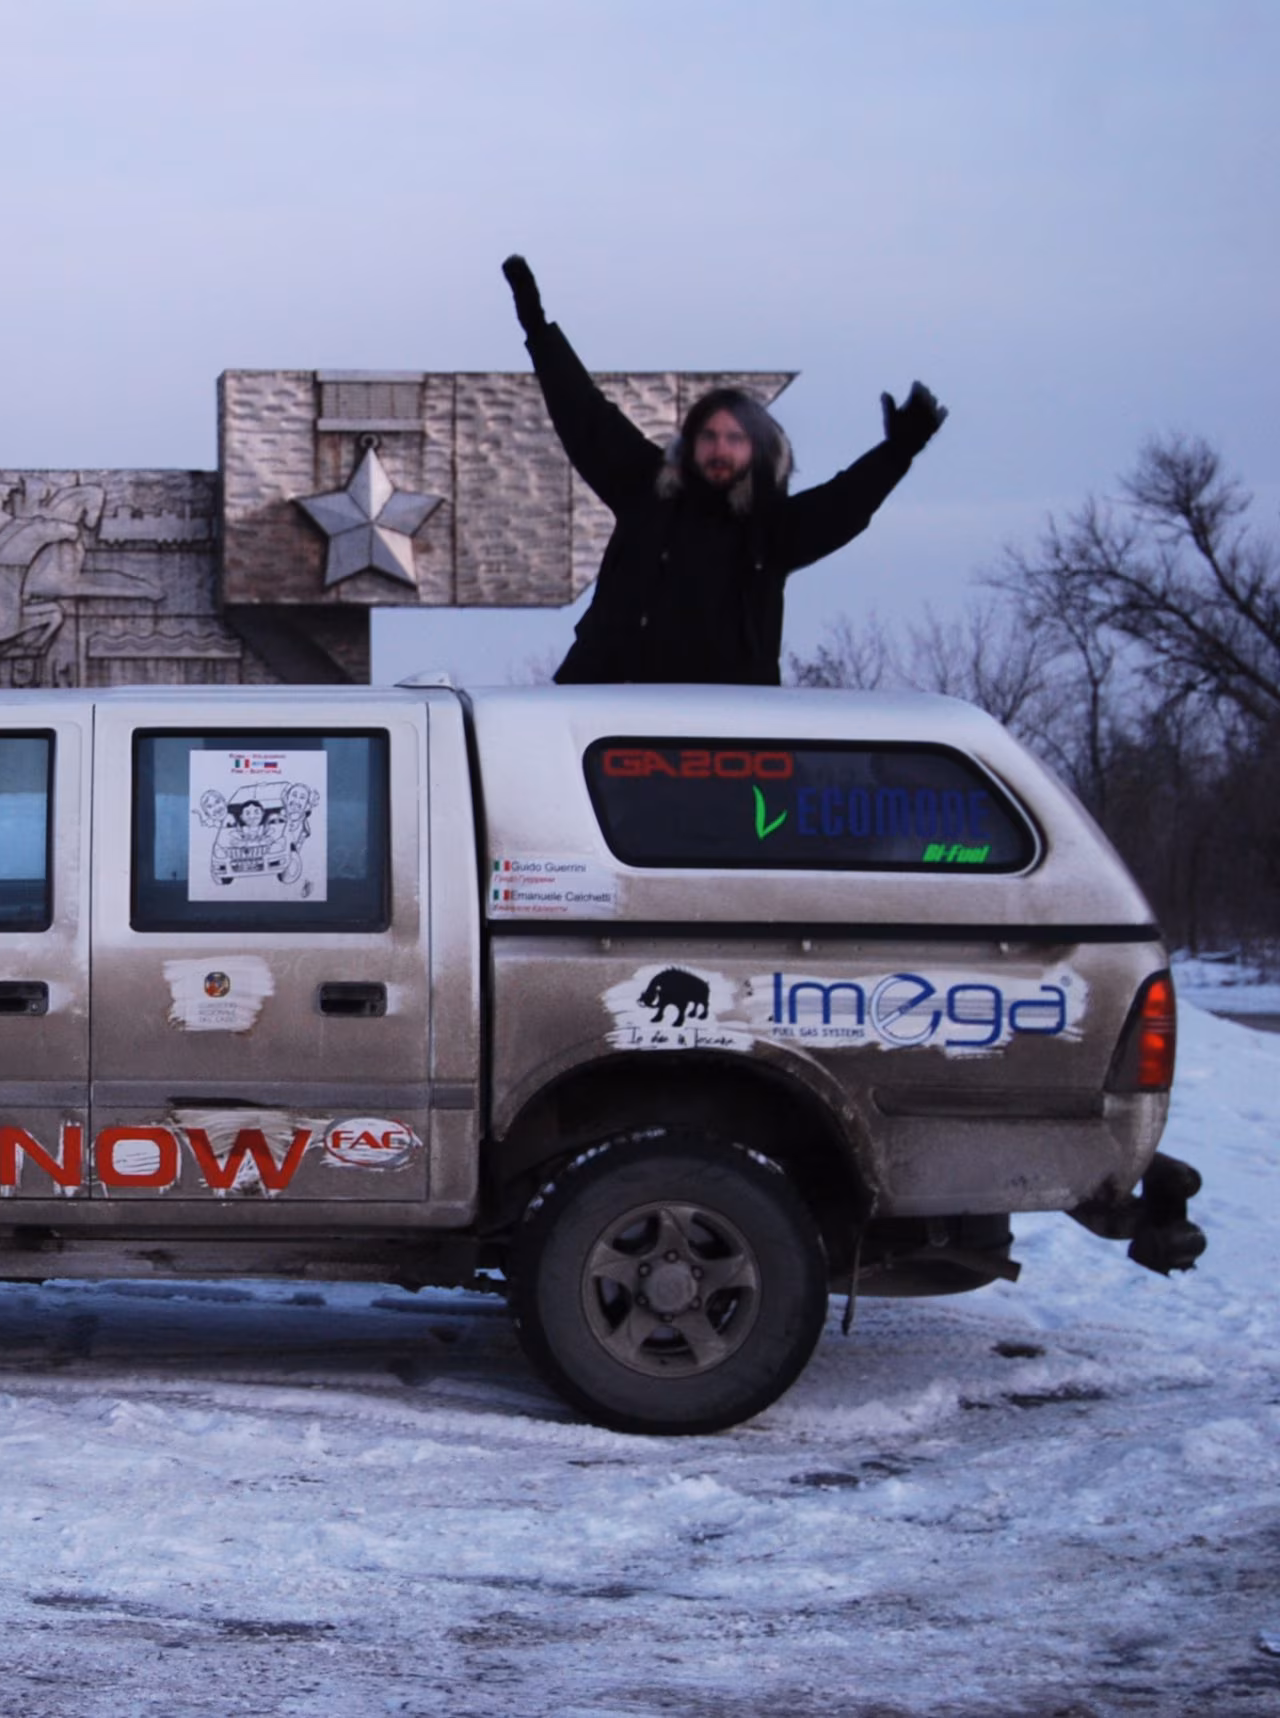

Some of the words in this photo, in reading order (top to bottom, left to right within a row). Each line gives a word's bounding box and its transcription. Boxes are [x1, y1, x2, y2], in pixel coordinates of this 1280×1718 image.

[603, 749, 794, 779] GA200
[795, 787, 991, 840] ECOMODE
[512, 860, 541, 873] Guido
[544, 862, 587, 873] Guerrini
[511, 890, 562, 901] Emanuele
[773, 1027, 796, 1037] FUEL
[799, 1027, 819, 1037] GAS
[822, 1027, 866, 1038] SYSTEMS
[331, 1130, 405, 1149] FAC
